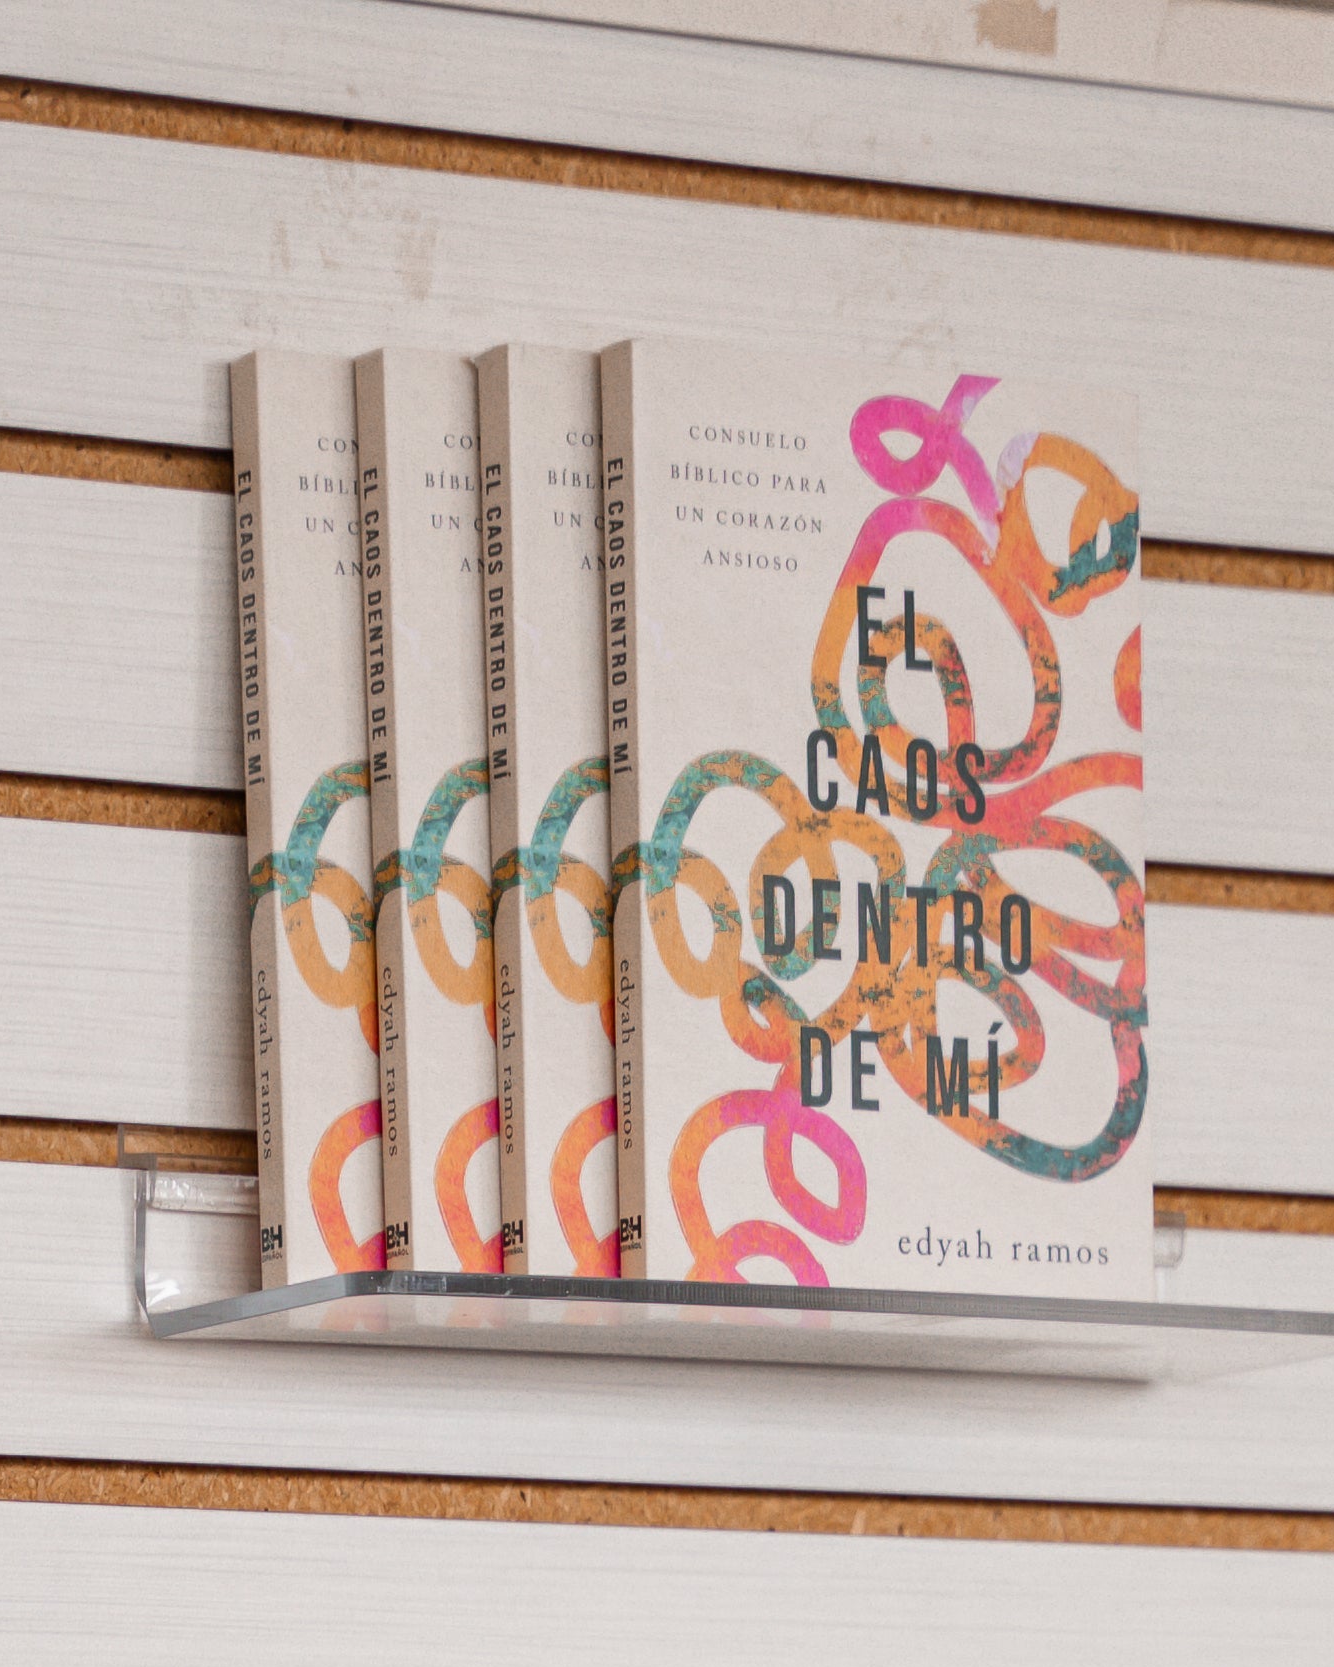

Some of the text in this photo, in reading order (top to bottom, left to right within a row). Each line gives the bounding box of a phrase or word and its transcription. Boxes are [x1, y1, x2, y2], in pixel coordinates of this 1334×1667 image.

[670, 463, 827, 494] BÍBLICO PARA
[689, 424, 808, 451] CONSUELO
[676, 506, 824, 533] UN CORAZÓN
[703, 549, 799, 572] ANSIOSO
[237, 469, 265, 786] EL CAOS DENTRO DE MÍ
[363, 467, 391, 783] EL CAOS DENTRO DE MÍ
[485, 463, 511, 780] EL CAOS DENTRO DE MÍ
[607, 457, 632, 775] EL CAOS DENTRO DE MÍ
[856, 585, 933, 672] EL
[806, 729, 987, 826] CAOS
[762, 874, 1032, 975] DENTRO
[257, 969, 274, 1160] edyah ramos
[383, 967, 399, 1158] edyah ramos
[500, 964, 516, 1155] edyah ramos
[619, 959, 636, 1151] edyah ramos
[799, 1021, 1003, 1120] DE MÍ
[897, 1226, 1109, 1267] edyah ramos
